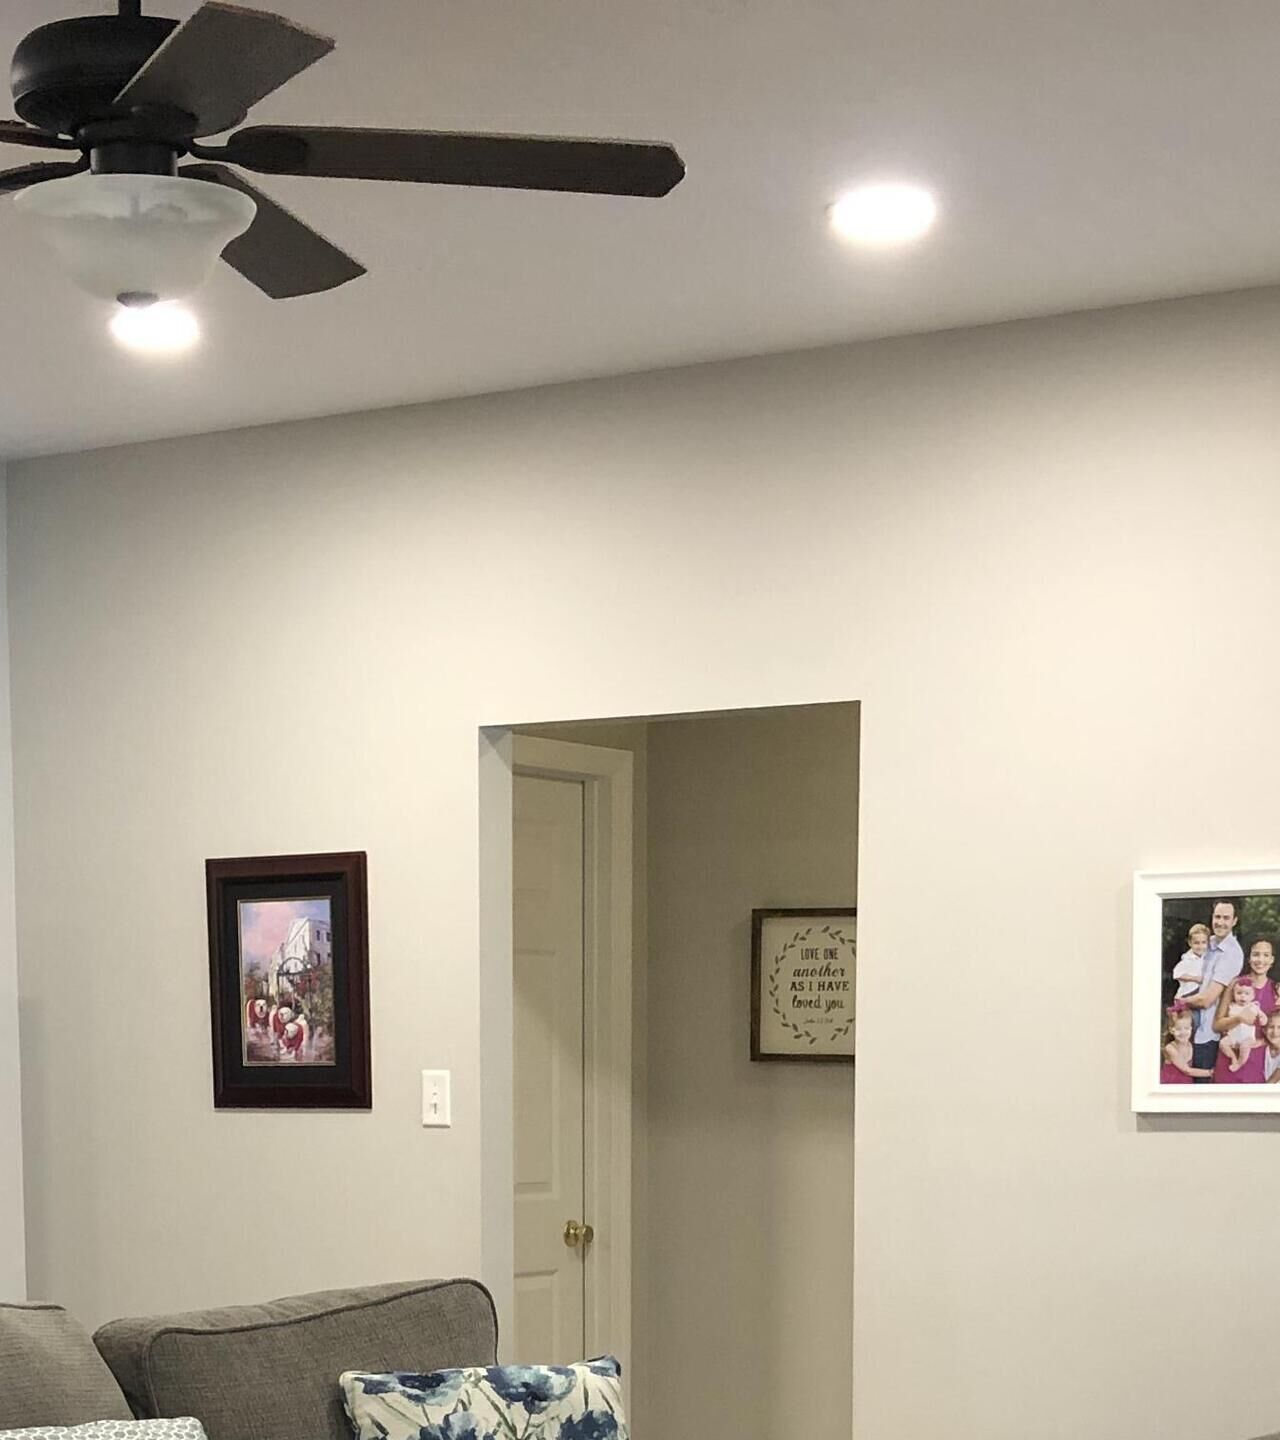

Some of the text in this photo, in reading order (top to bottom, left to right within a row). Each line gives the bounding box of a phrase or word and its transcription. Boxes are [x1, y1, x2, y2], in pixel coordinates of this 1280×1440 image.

[800, 947, 839, 961] LOVE ONE
[792, 961, 846, 978] another
[790, 981, 850, 992] AS I HAVE
[791, 994, 845, 1014] loved you
